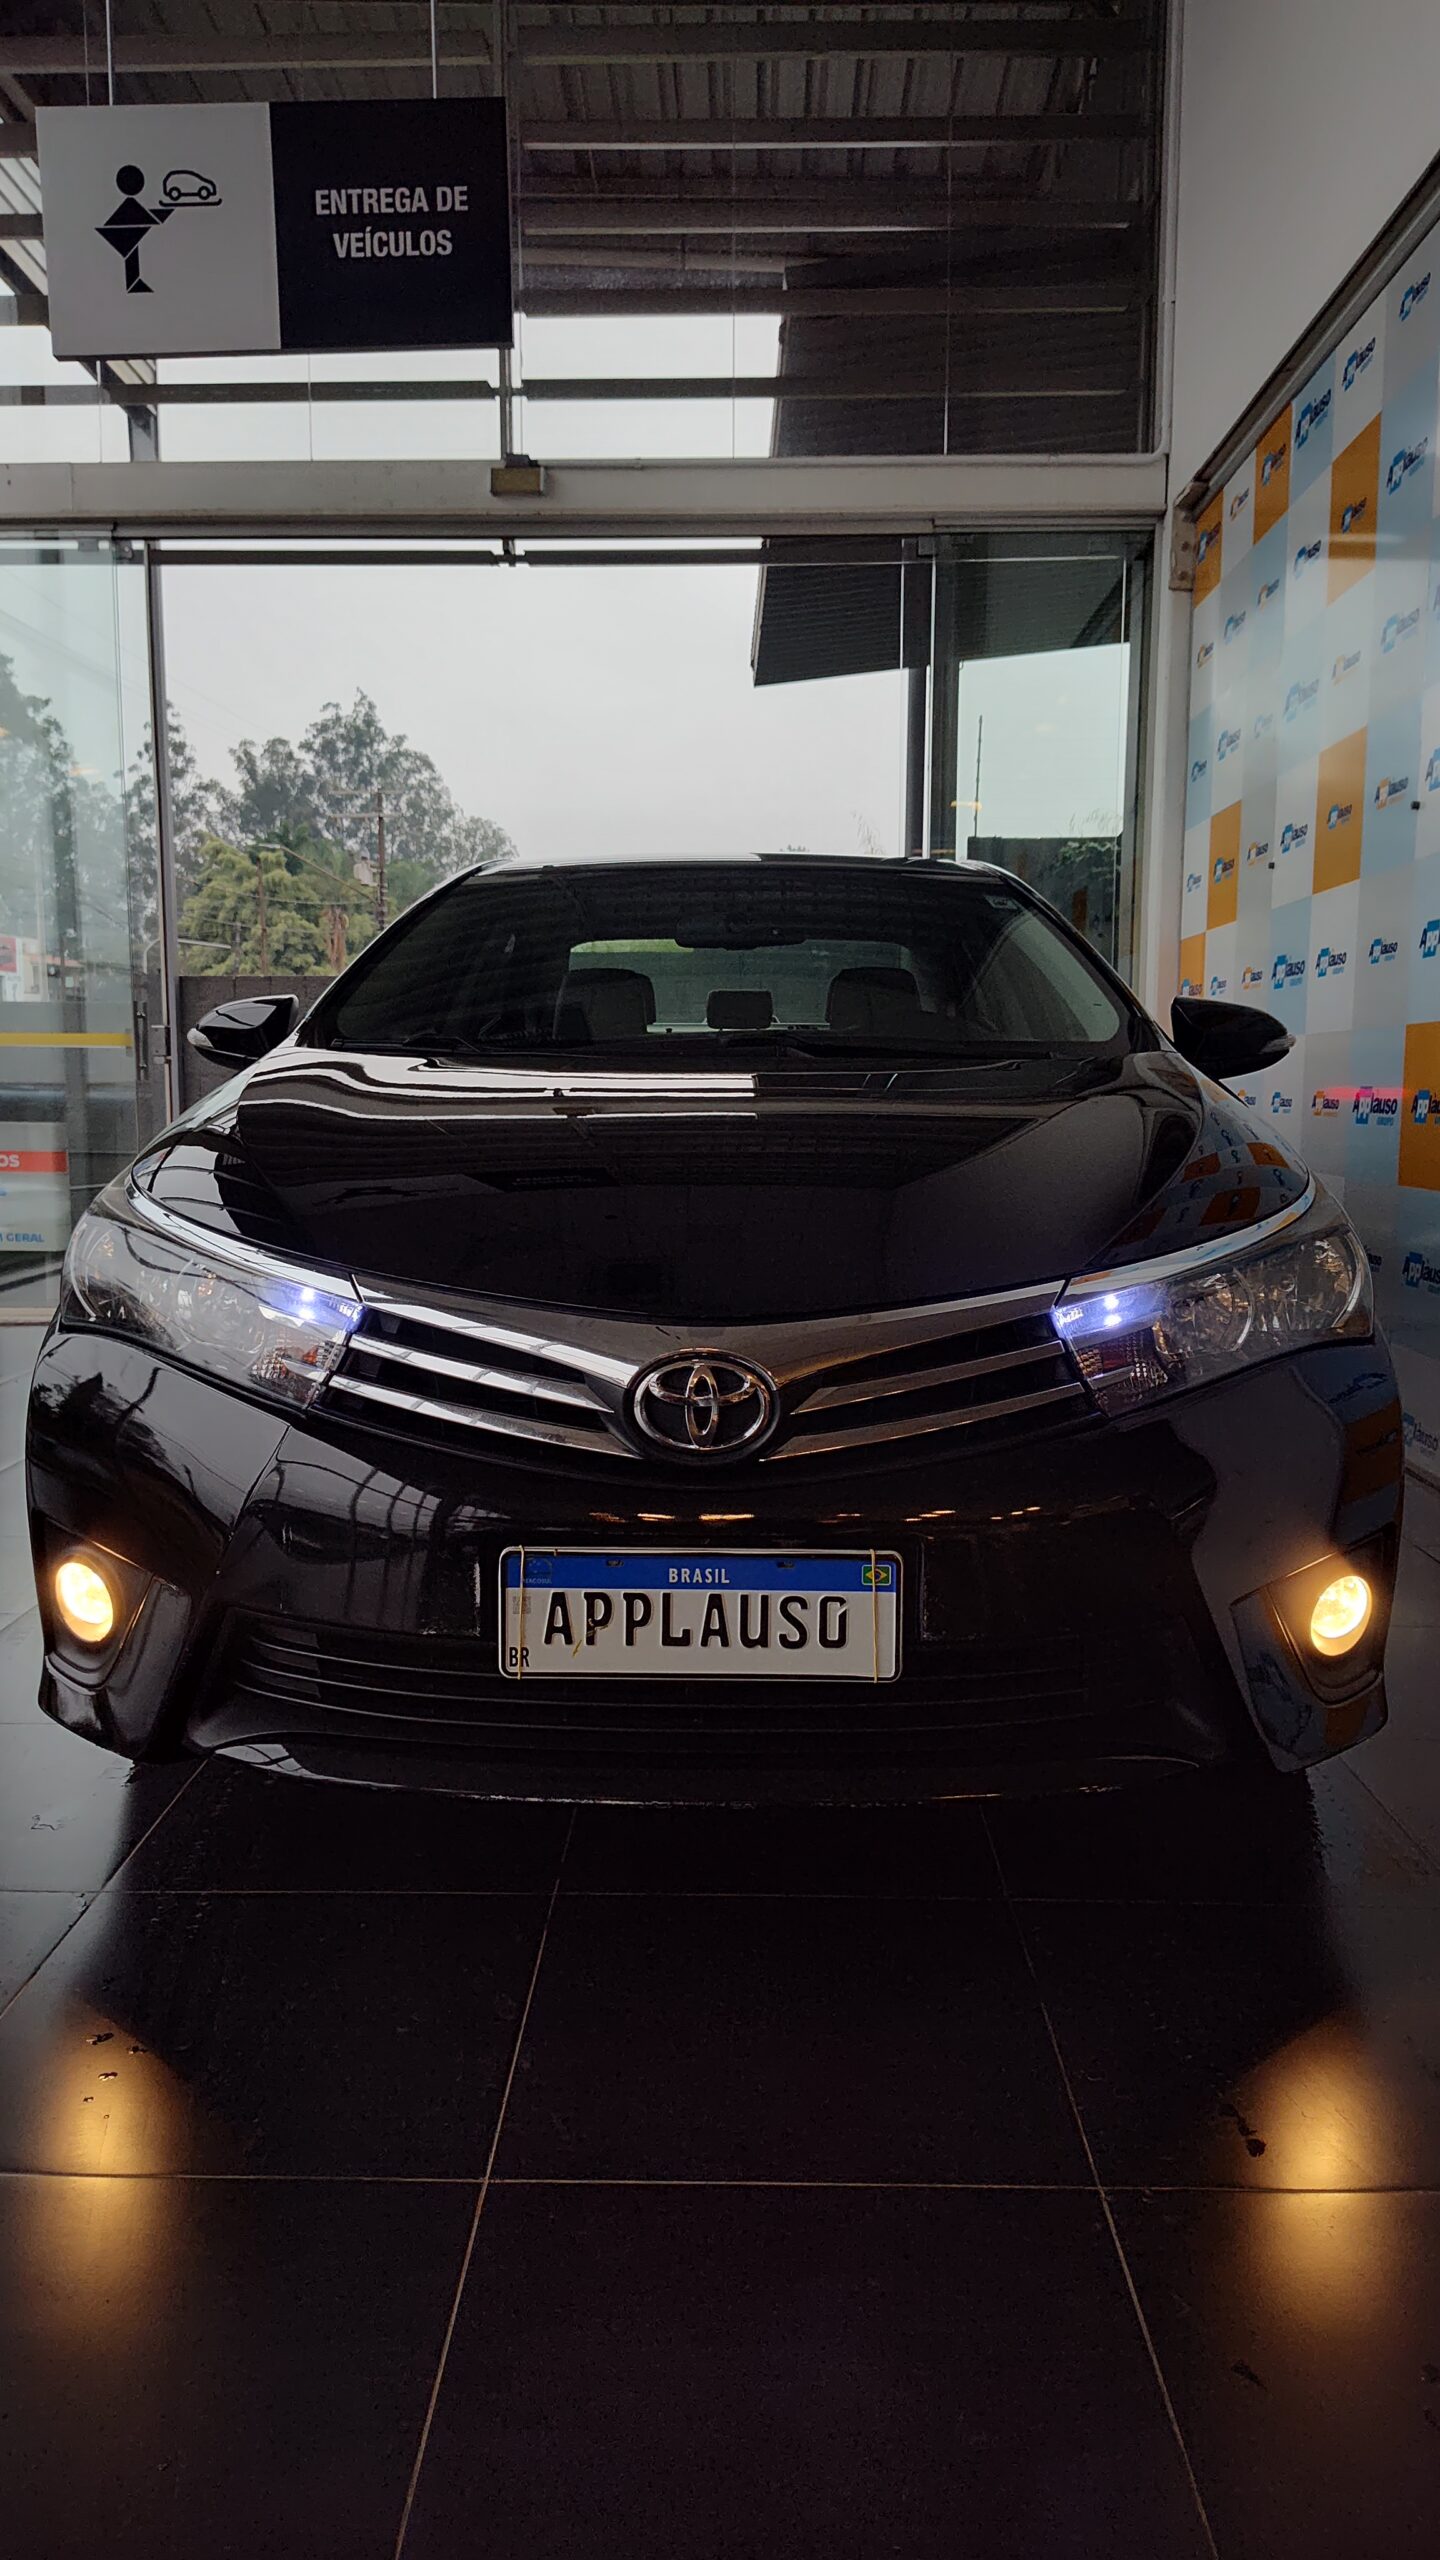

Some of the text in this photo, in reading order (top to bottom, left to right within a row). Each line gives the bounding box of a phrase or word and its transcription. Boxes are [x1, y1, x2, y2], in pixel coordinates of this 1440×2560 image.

[315, 186, 469, 215] ENTREGA DE
[333, 226, 453, 259] VEÍCULOS
[668, 1567, 730, 1584] BRASIL
[543, 1591, 849, 1650] APPLAUSO
[509, 1646, 529, 1668] BR
